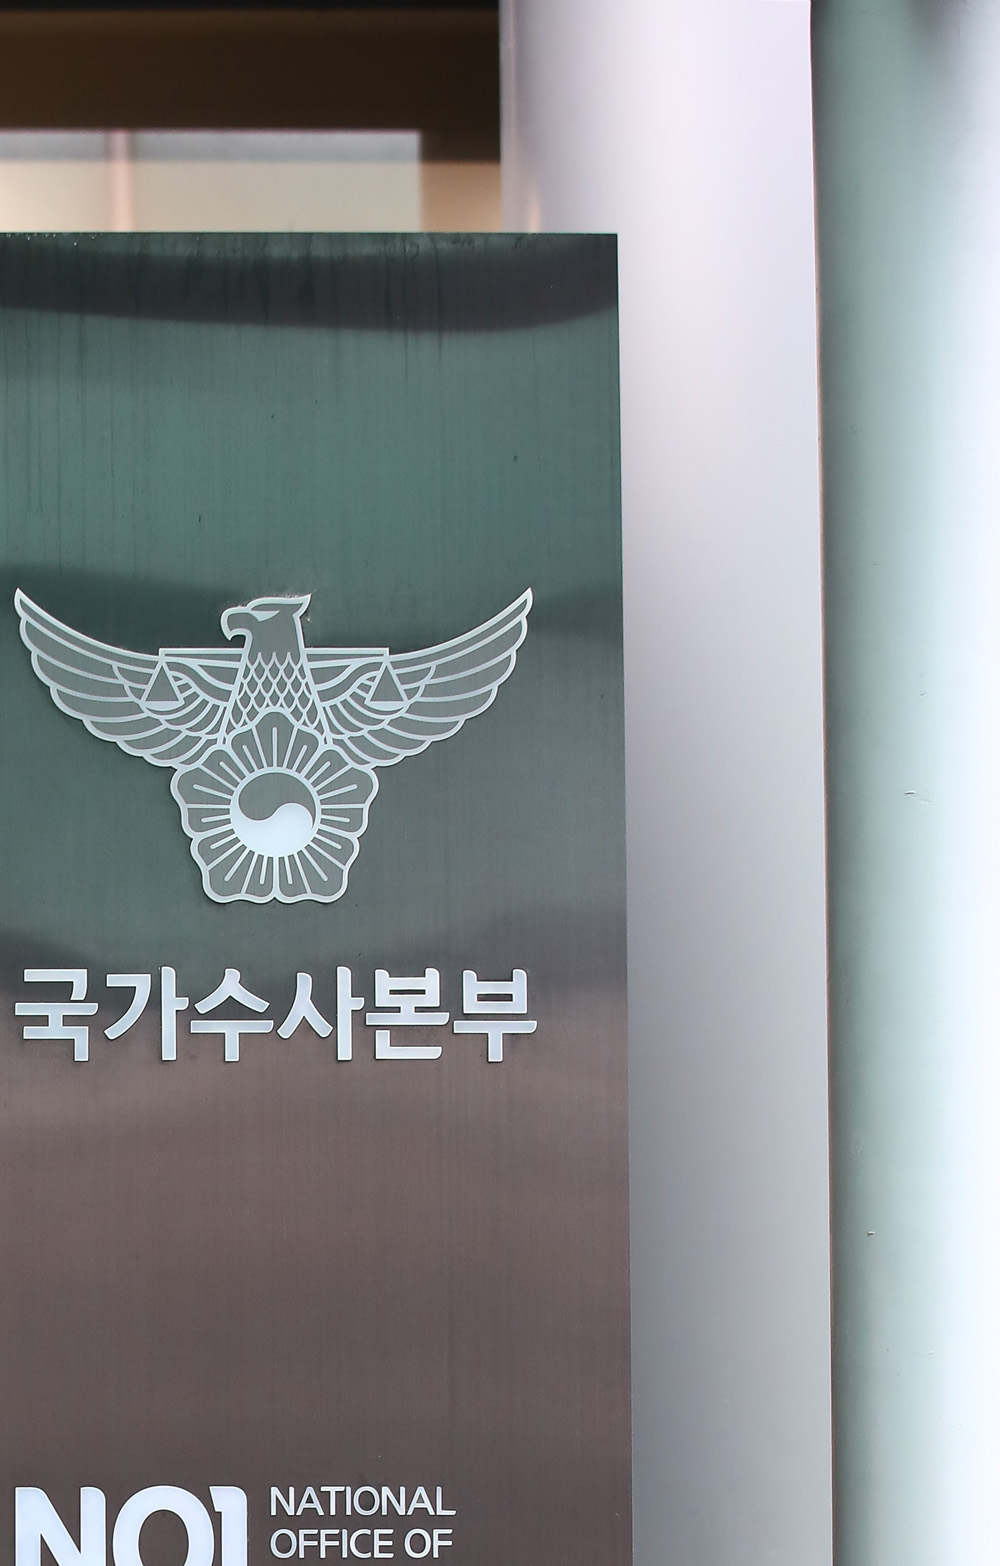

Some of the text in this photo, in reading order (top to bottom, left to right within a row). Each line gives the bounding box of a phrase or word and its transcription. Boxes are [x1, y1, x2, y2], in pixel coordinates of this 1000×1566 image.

[15, 965, 538, 1062] 국가수사본부
[269, 1485, 456, 1516] NATIONAL
[269, 1527, 453, 1559] OFFICE OF
